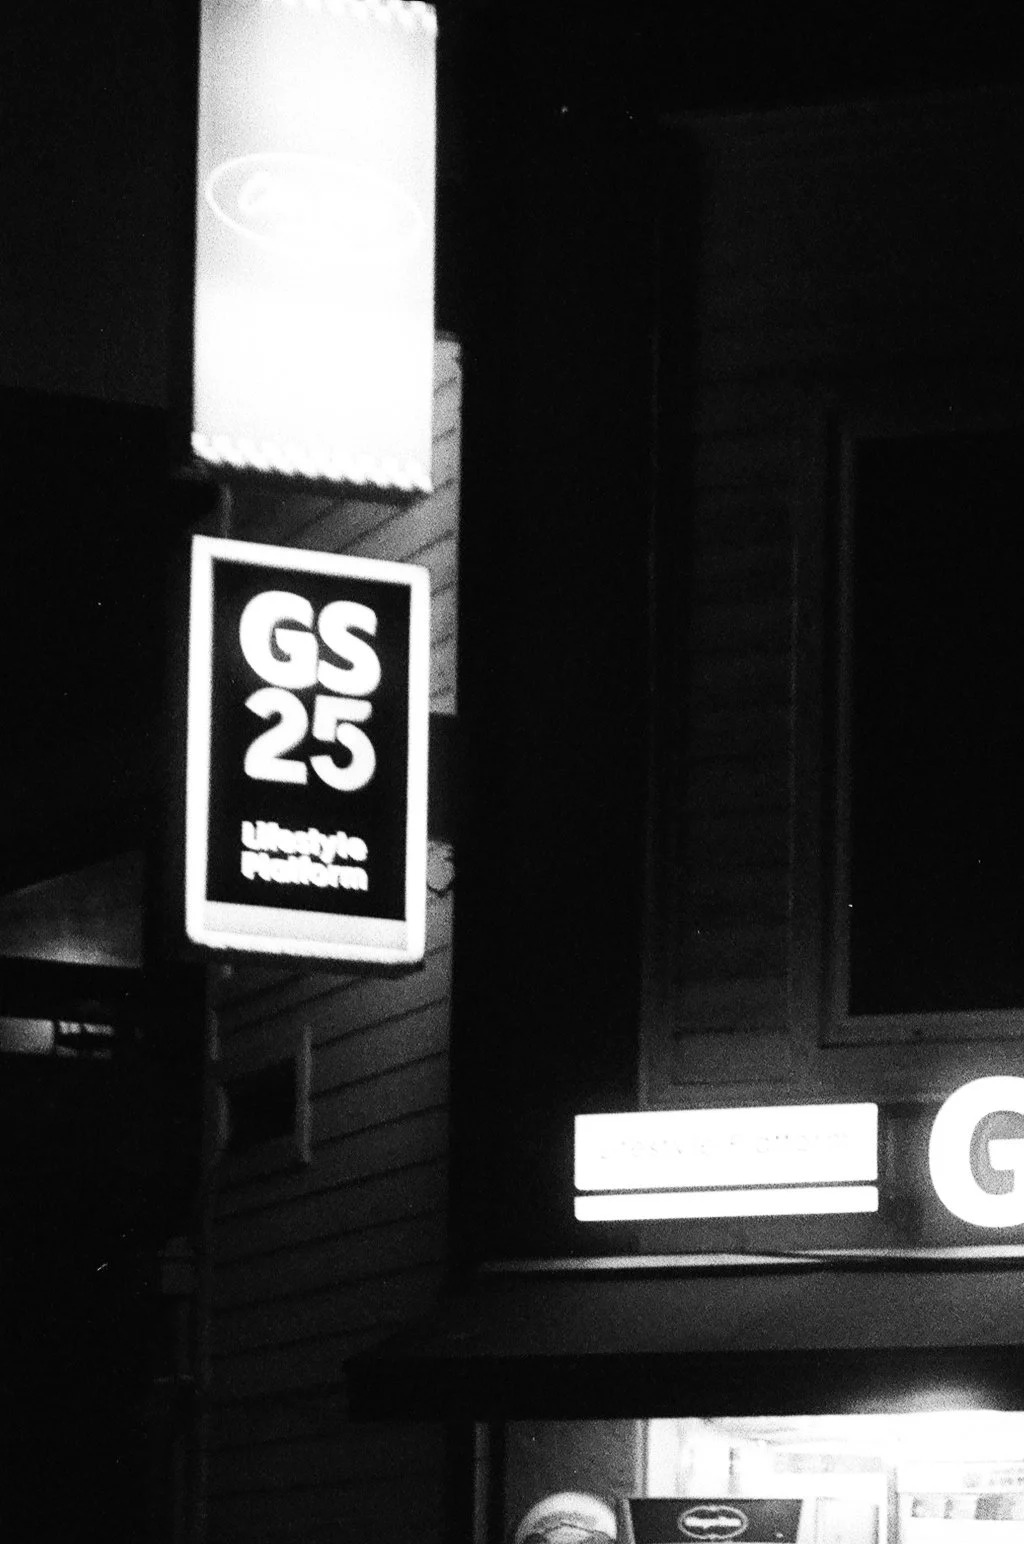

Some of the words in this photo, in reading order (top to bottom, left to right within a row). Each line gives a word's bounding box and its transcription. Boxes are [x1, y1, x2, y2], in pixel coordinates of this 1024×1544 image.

[239, 588, 382, 697] GS
[243, 687, 377, 793] 25
[240, 851, 369, 891] Platform
[241, 820, 369, 864] Lifestyle
